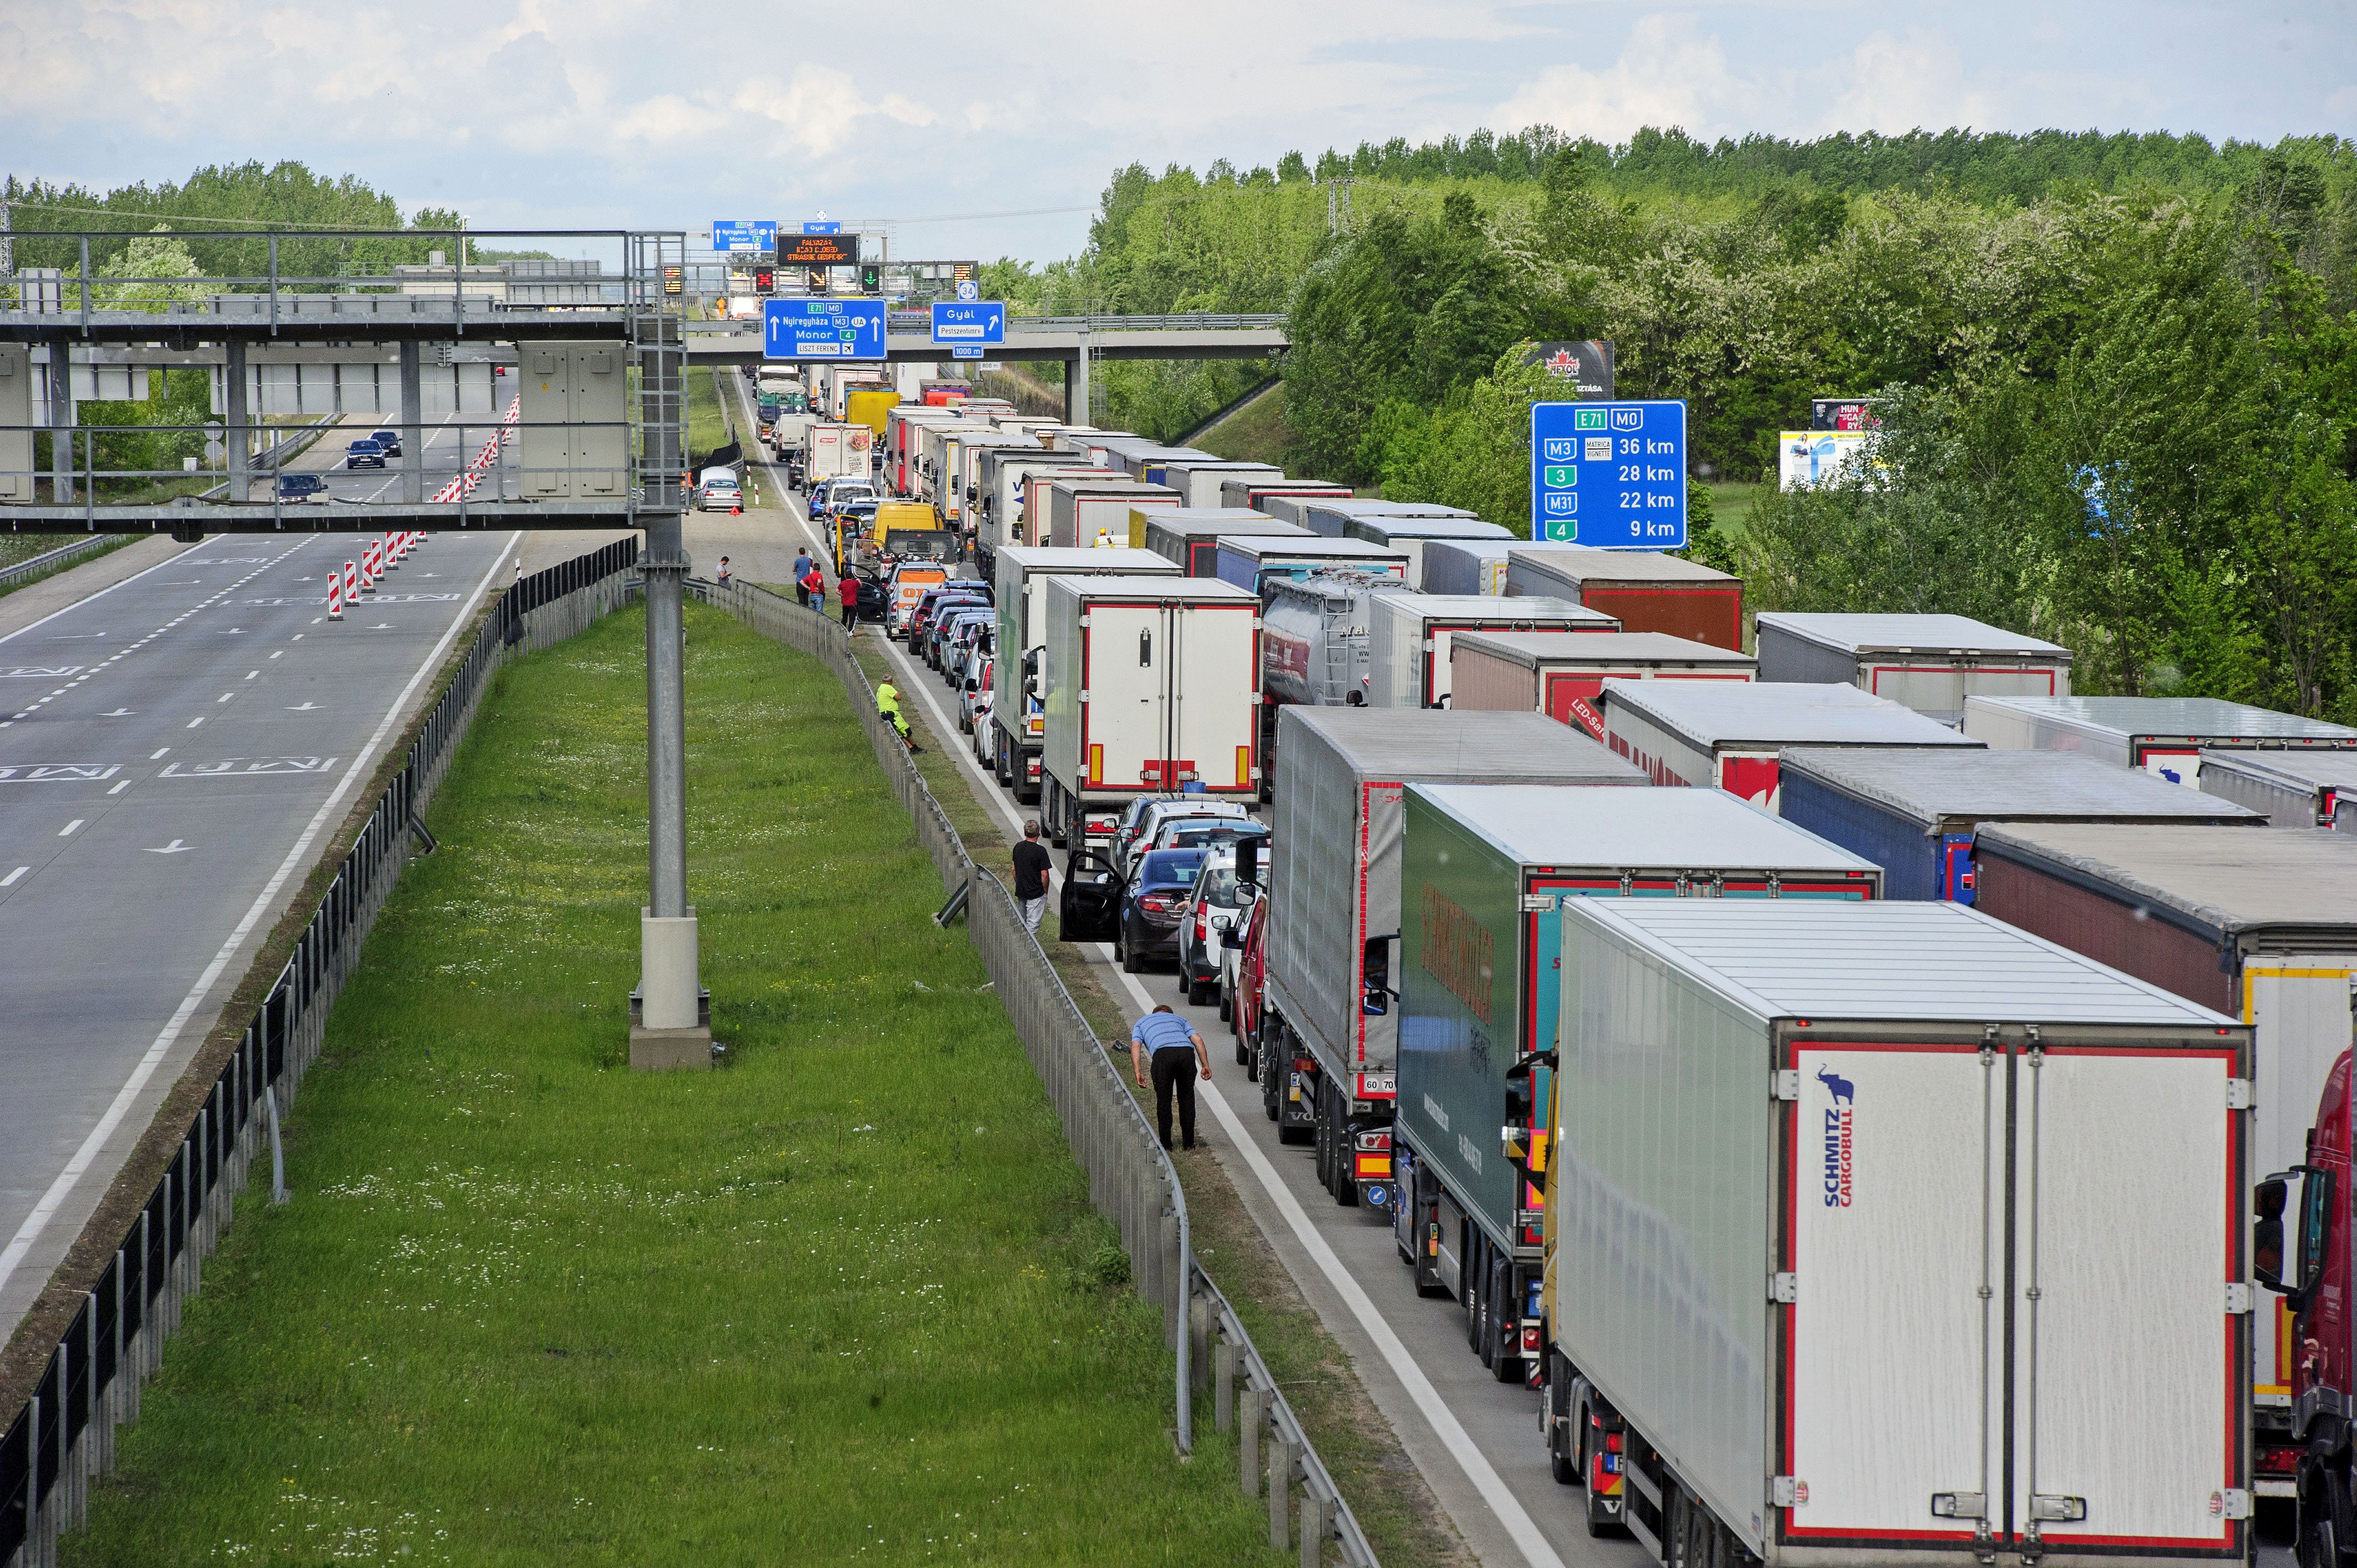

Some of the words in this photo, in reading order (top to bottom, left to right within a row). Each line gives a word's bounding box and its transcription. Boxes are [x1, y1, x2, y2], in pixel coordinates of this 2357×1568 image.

[783, 316, 828, 327] Nyíregyháza
[947, 310, 975, 320] Gyál
[796, 330, 833, 339] Monor
[1841, 405, 1859, 413] HUN
[1617, 412, 1637, 425] M0
[1551, 442, 1571, 455] M3
[1619, 439, 1640, 454] 36
[1646, 439, 1674, 454] km
[1556, 470, 1566, 482] 3
[1619, 465, 1640, 481] 28
[1646, 465, 1674, 481] km
[1551, 496, 1572, 509] M31
[1620, 492, 1641, 508] 22
[1646, 492, 1674, 508] km
[1556, 524, 1566, 537] 4
[1630, 520, 1640, 537] 9
[1646, 520, 1674, 537] km
[1383, 1081, 1393, 1089] 70
[1825, 1108, 1839, 1207] SCHMITZ
[1840, 1108, 1852, 1208] CARGOBULL
